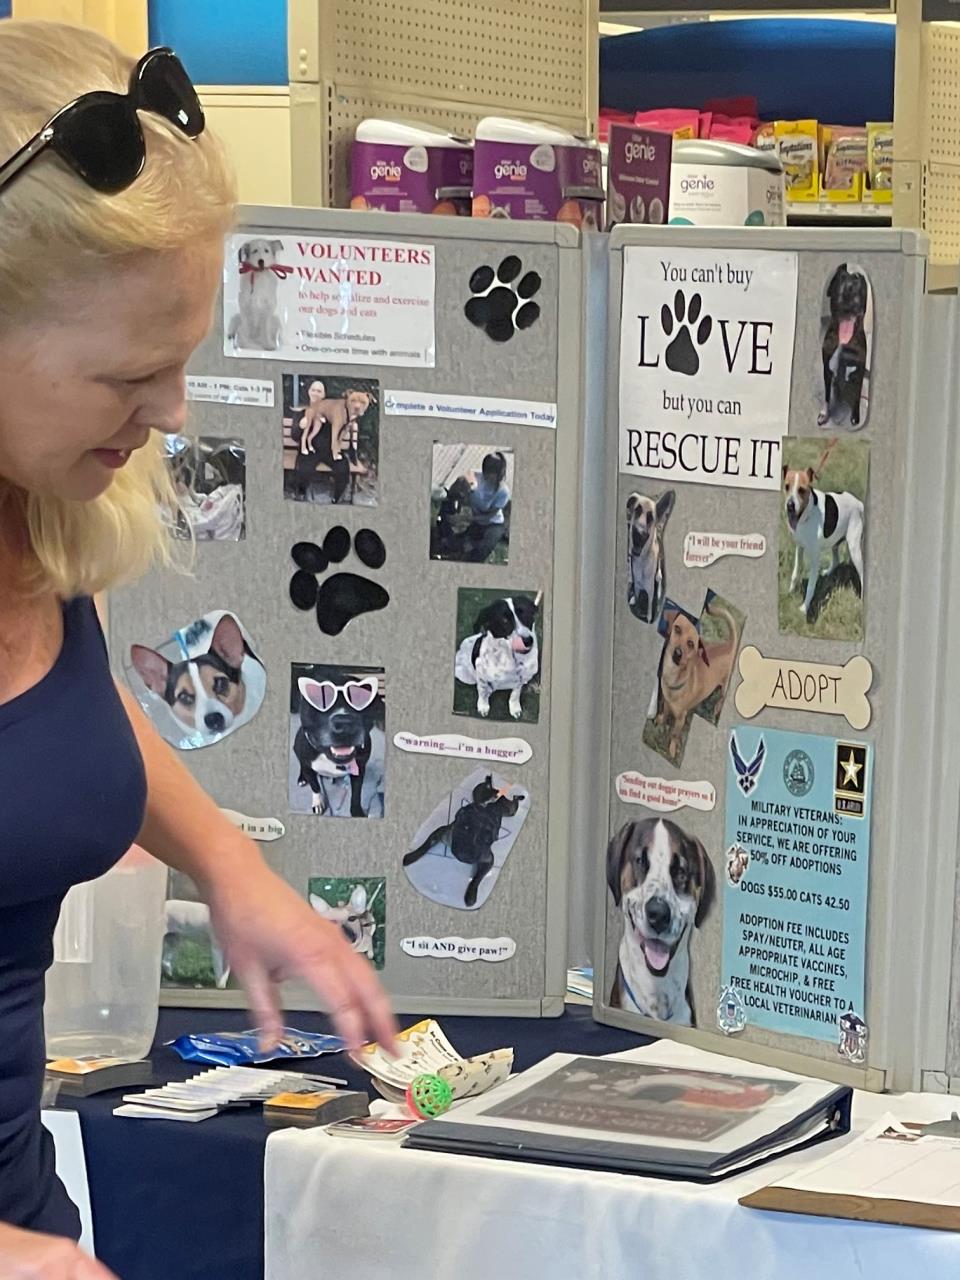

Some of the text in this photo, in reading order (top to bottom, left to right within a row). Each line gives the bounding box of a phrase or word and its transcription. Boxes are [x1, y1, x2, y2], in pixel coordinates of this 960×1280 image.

[625, 139, 656, 162] genie
[371, 160, 401, 180] genie
[495, 161, 527, 180] genie
[680, 175, 715, 193] genie
[297, 242, 431, 265] VOLUNTEERS
[297, 267, 382, 285] WANTED
[661, 261, 753, 291] You can't buy
[637, 300, 773, 375] LVE
[436, 404, 476, 415] Volunteer
[480, 408, 527, 419] Application
[531, 412, 555, 423] Today
[662, 390, 742, 419] but you can
[626, 429, 780, 479] RESCUE IT
[698, 536, 710, 548] will
[712, 537, 720, 548] be
[722, 540, 738, 551] your
[740, 538, 764, 550] friend
[771, 668, 842, 703] ADOPT
[751, 800, 843, 825] MILITARY VETERANS:
[738, 815, 856, 844] IN APPRECIATION OF YOUR
[750, 851, 842, 876] 50% OFF ADOPTIONS
[418, 940, 429, 950] sit
[431, 943, 455, 952] AND
[458, 944, 476, 955] give
